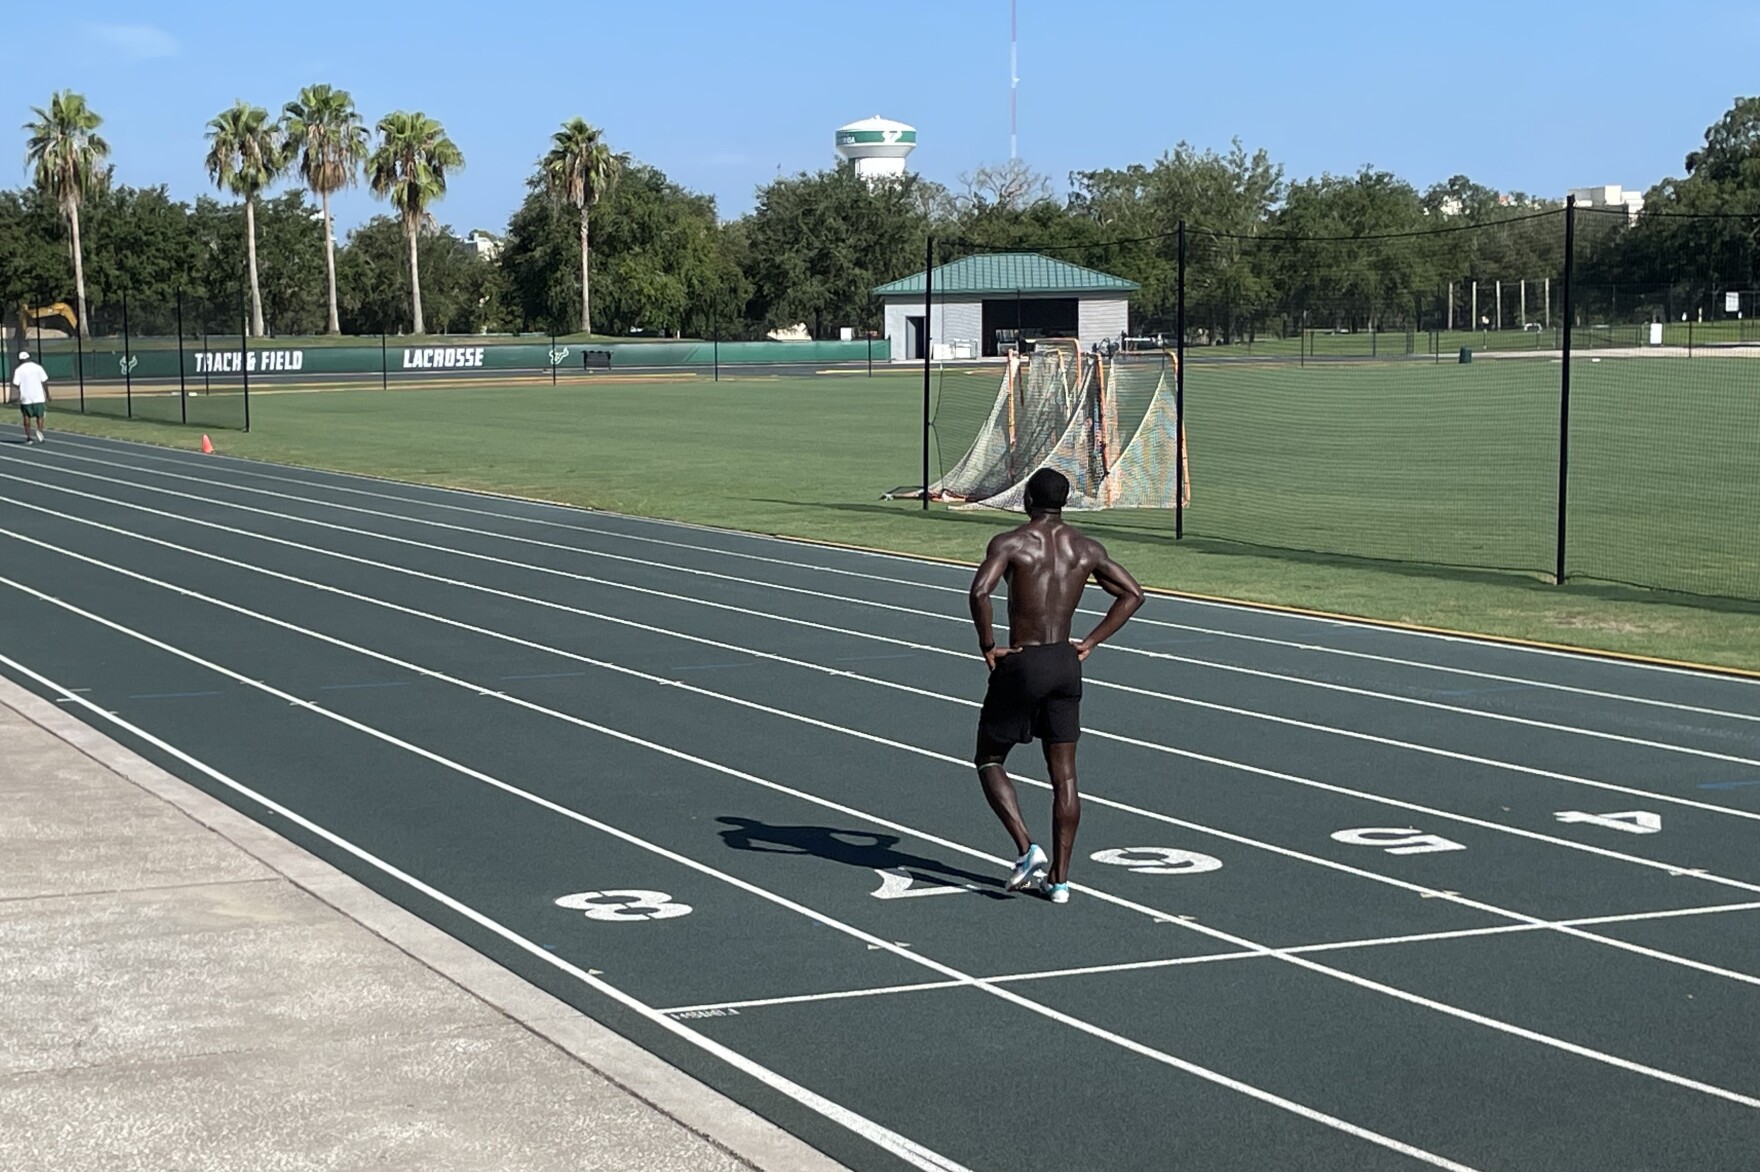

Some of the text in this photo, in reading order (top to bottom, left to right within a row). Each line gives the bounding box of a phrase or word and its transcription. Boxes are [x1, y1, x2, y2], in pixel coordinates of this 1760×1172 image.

[194, 350, 303, 372] TRACK & FIELD
[403, 348, 484, 368] LACROSSE
[1554, 810, 1662, 834] 4
[1331, 827, 1467, 855] 5
[1090, 847, 1223, 874] 6
[555, 889, 693, 921] 8
